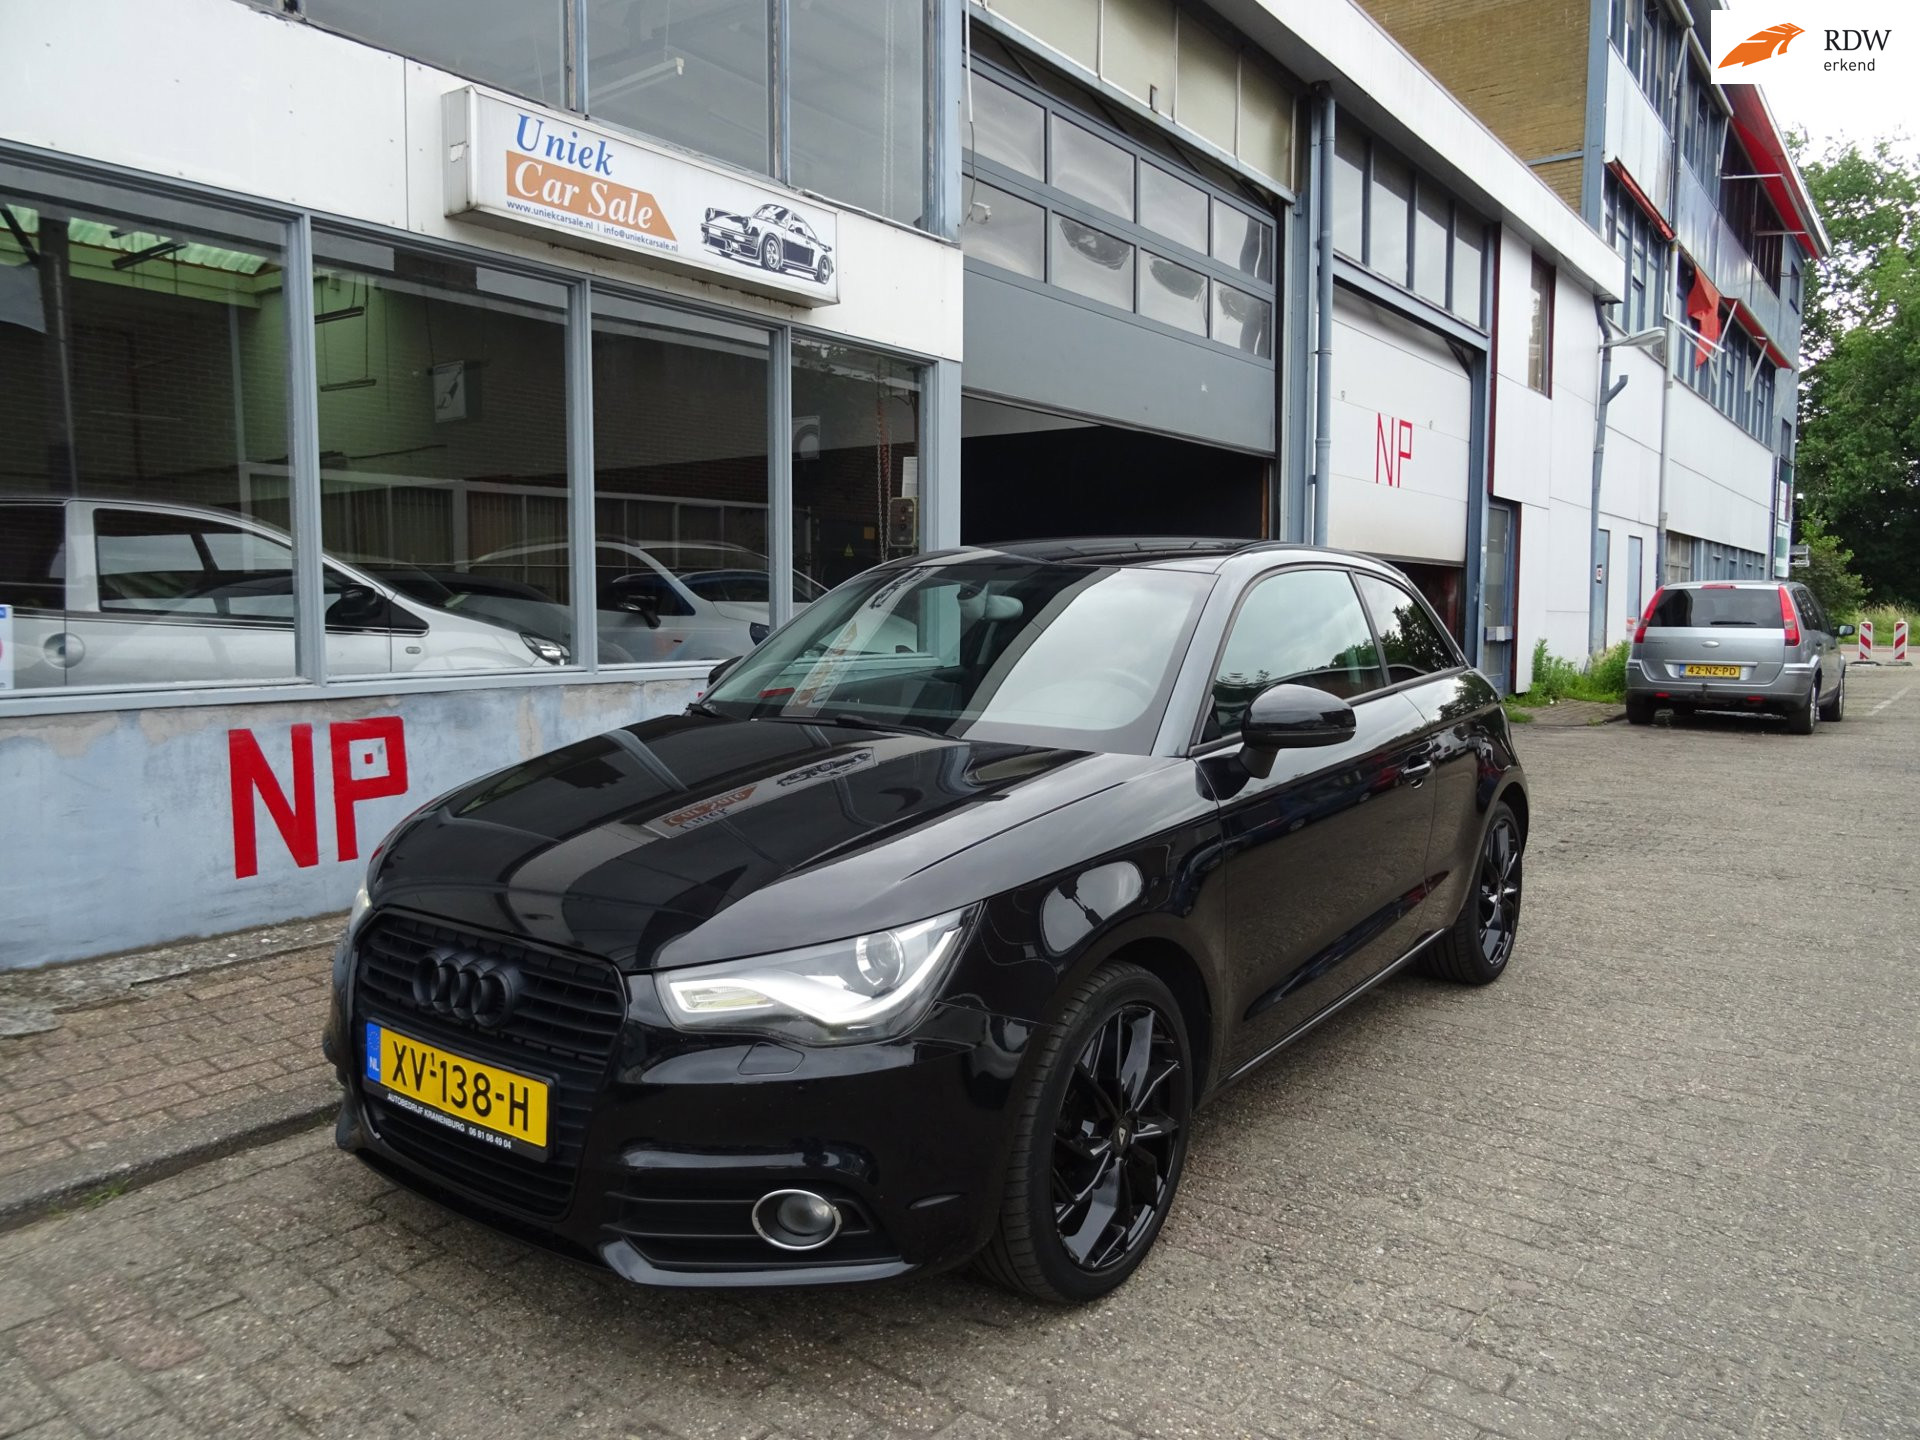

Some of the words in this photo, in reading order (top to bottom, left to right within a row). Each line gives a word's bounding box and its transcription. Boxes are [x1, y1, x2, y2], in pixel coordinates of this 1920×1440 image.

[515, 113, 615, 176] Uniek
[506, 199, 594, 230] www.uniekcarsale.nl
[603, 223, 679, 253] info@uniekcarsale.nl
[514, 160, 580, 207] Car
[587, 180, 654, 230] Sale
[1376, 412, 1413, 488] NP
[1687, 666, 1737, 676] 42-NZ-PD
[228, 716, 409, 879] NP
[369, 1056, 380, 1072] NL
[392, 1040, 529, 1132] XV-138-H
[387, 1092, 424, 1114] AUTOBEDRIJF
[424, 1108, 465, 1132] KRANENBURG
[468, 1126, 477, 1137] 06
